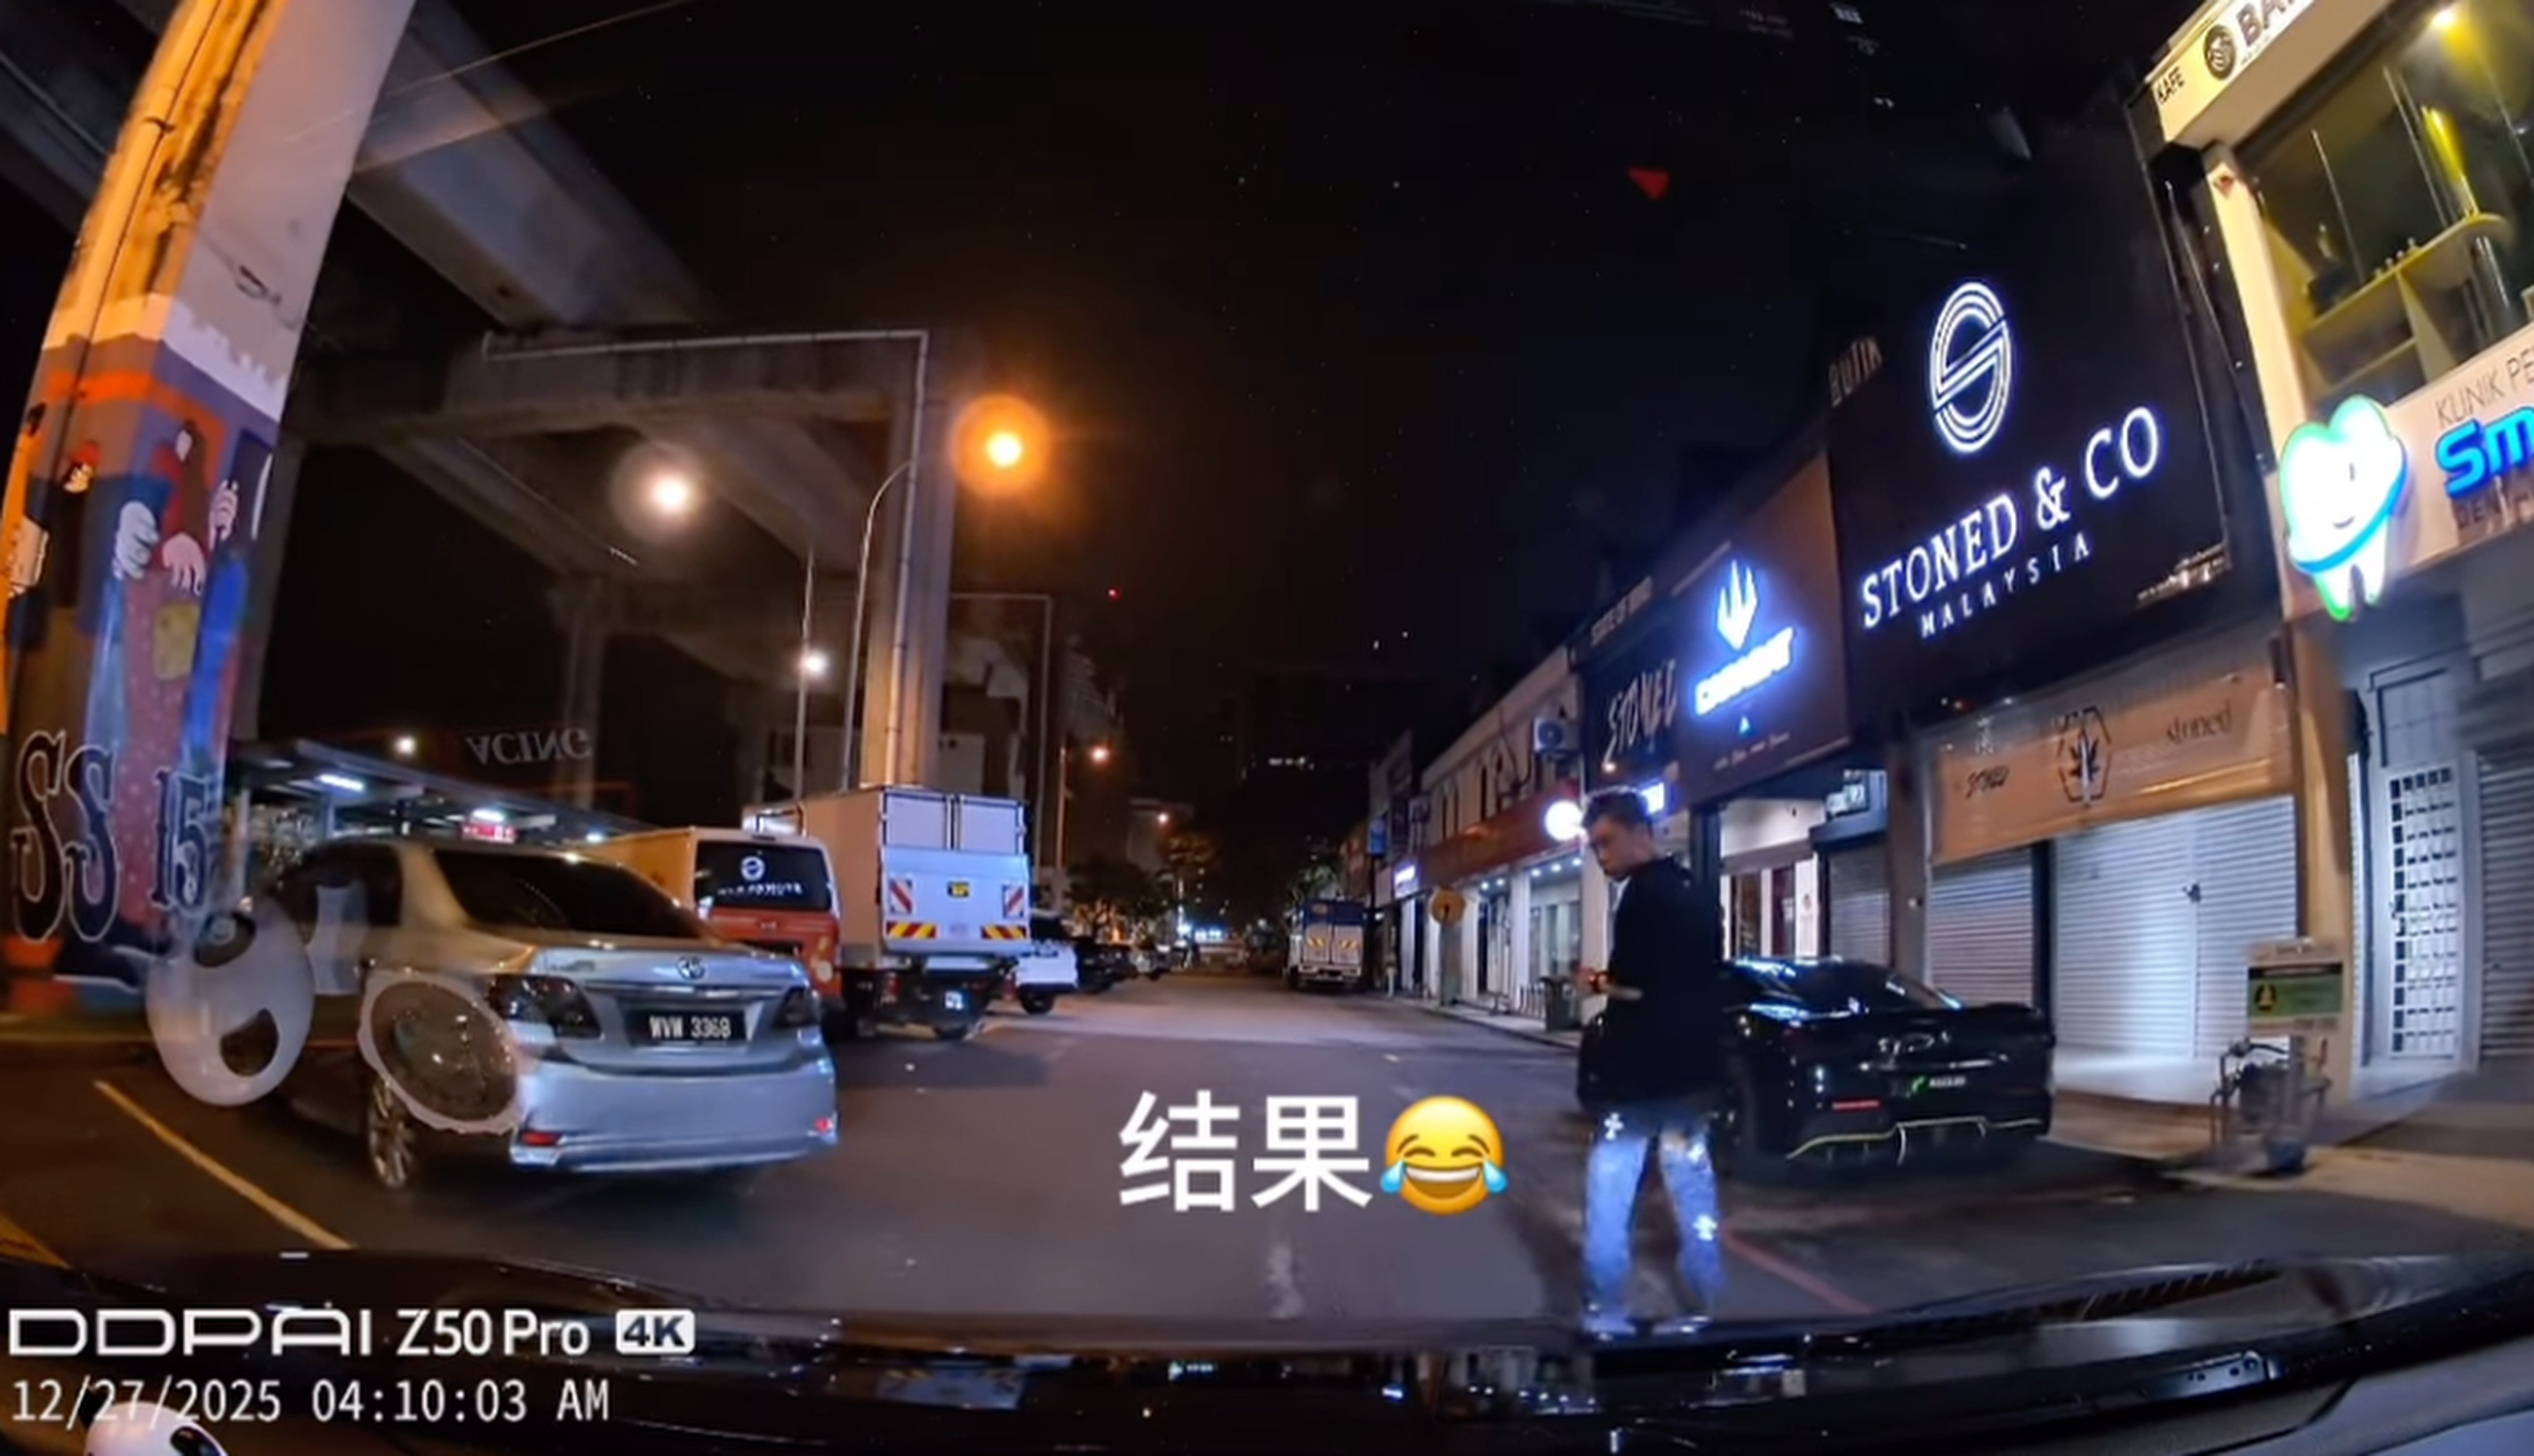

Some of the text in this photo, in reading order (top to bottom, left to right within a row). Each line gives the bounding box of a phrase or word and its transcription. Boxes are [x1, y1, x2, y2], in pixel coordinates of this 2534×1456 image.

[1863, 406, 2159, 629] STONED & CO
[1921, 532, 2091, 639] MALAYSIA
